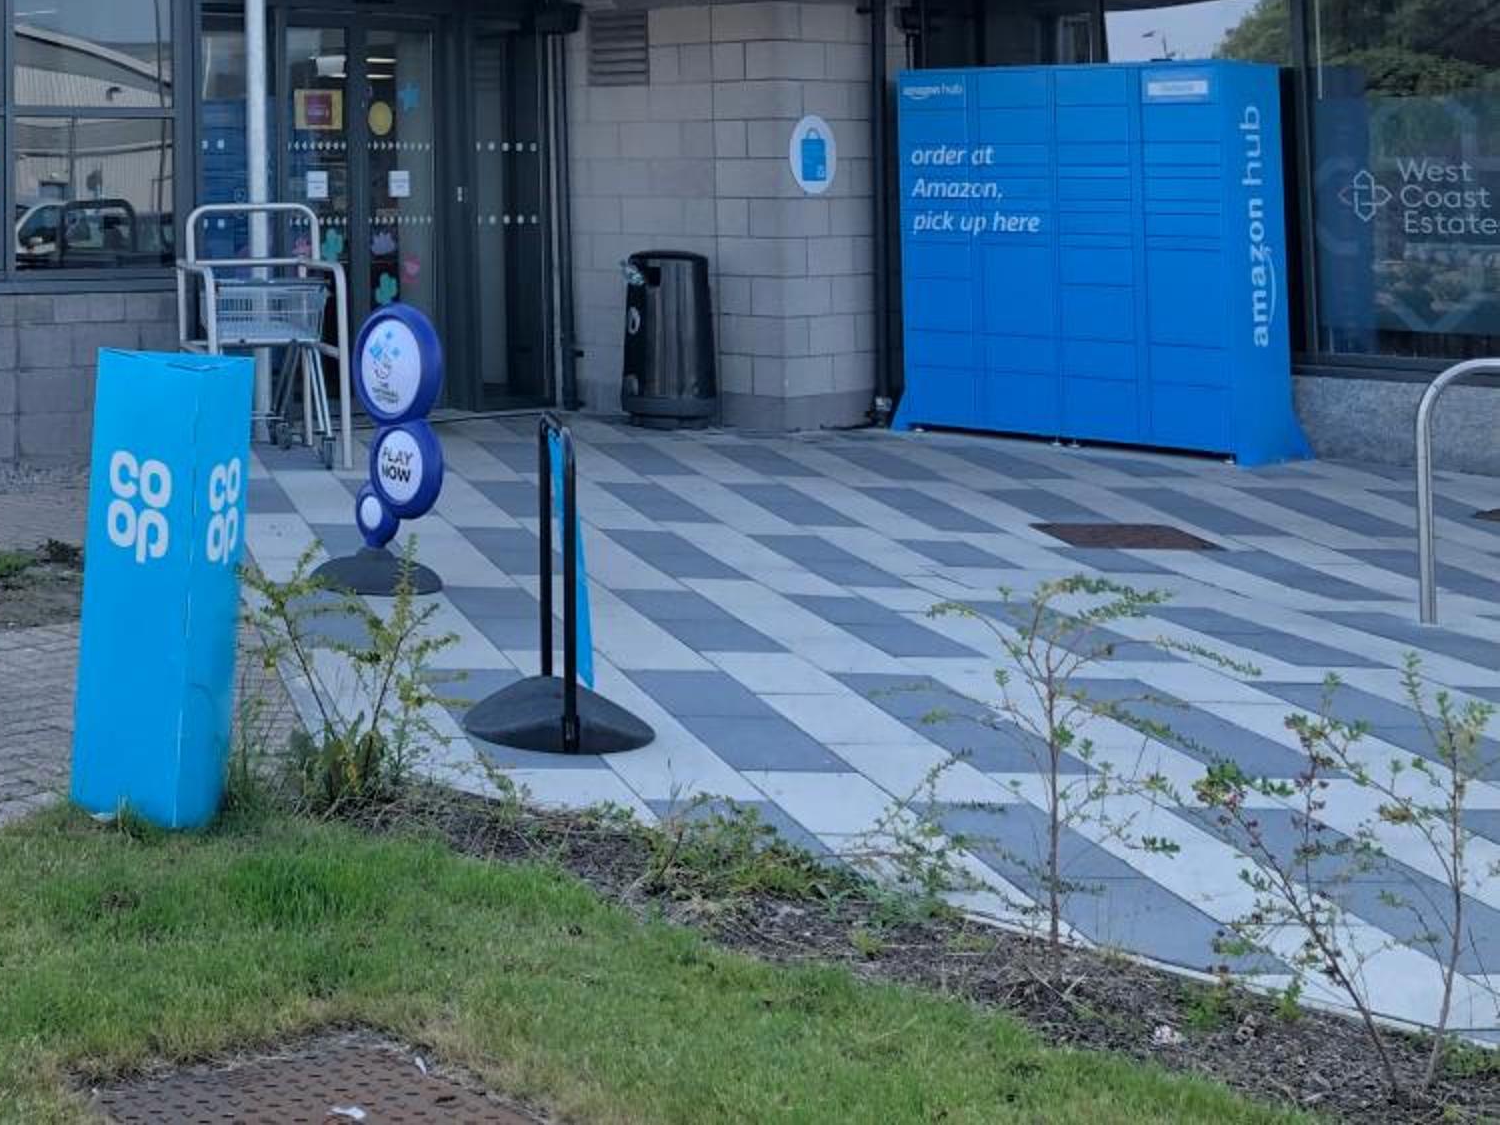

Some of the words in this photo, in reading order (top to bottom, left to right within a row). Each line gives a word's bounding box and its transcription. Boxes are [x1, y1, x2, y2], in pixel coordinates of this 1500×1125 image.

[911, 145, 966, 165] order
[971, 145, 995, 165] at
[1240, 105, 1263, 186] hub
[1396, 157, 1476, 183] West
[911, 178, 1003, 201] Amazon,
[1399, 184, 1493, 209] Coast
[913, 210, 958, 235] pick
[960, 216, 987, 236] up
[992, 211, 1041, 233] here
[1403, 210, 1500, 234] Estate
[1248, 197, 1271, 348] amazon
[382, 446, 414, 467] PLAY
[381, 464, 411, 483] NOW
